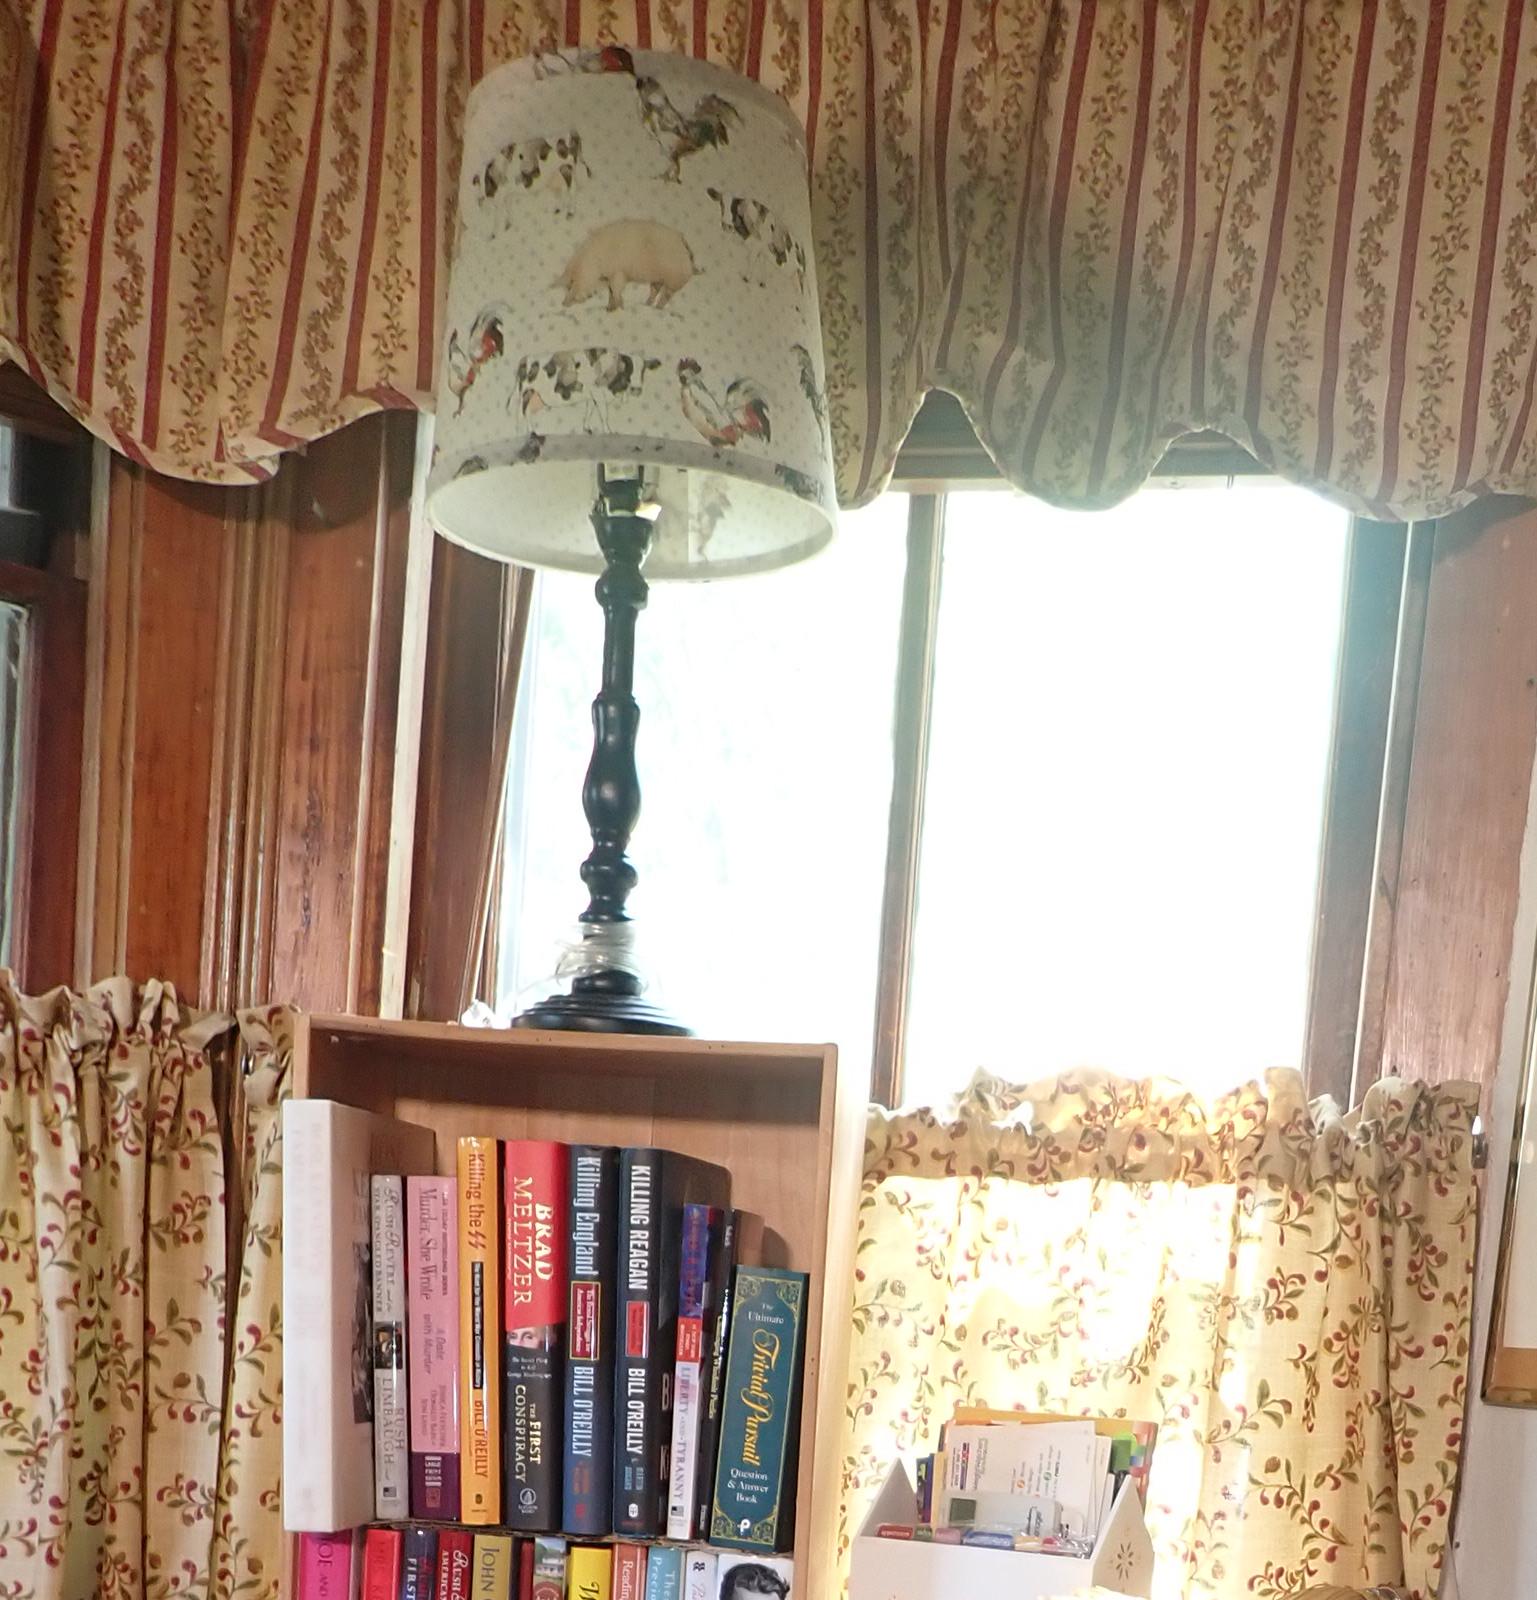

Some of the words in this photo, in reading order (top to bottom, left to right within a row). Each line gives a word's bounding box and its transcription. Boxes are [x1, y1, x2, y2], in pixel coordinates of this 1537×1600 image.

[574, 1156, 600, 1207] Killing
[631, 1165, 650, 1224] KILLING
[469, 1204, 484, 1227] the
[512, 1176, 533, 1306] MELTZER
[535, 1203, 553, 1279] BRAD
[420, 1237, 434, 1261] She
[573, 1212, 598, 1276] England
[628, 1229, 648, 1289] REAGAN
[420, 1264, 436, 1299] Wrote
[573, 1366, 591, 1395] BILL
[628, 1368, 644, 1396] BILL
[746, 1329, 780, 1396] Trivial
[678, 1366, 692, 1413] LIBERTY
[382, 1378, 394, 1464] LIMBAUGH
[514, 1384, 527, 1483] CONSPIRACY
[529, 1421, 541, 1464] FIRST
[572, 1399, 591, 1456] O'REILLY
[626, 1401, 644, 1454] O'REILLY
[740, 1393, 774, 1466] Pursuit
[672, 1440, 686, 1499] TYRANNY
[731, 1467, 768, 1483] Question
[736, 1492, 758, 1504] Book
[319, 1575, 328, 1596] AND
[480, 1547, 499, 1592] JOHN
